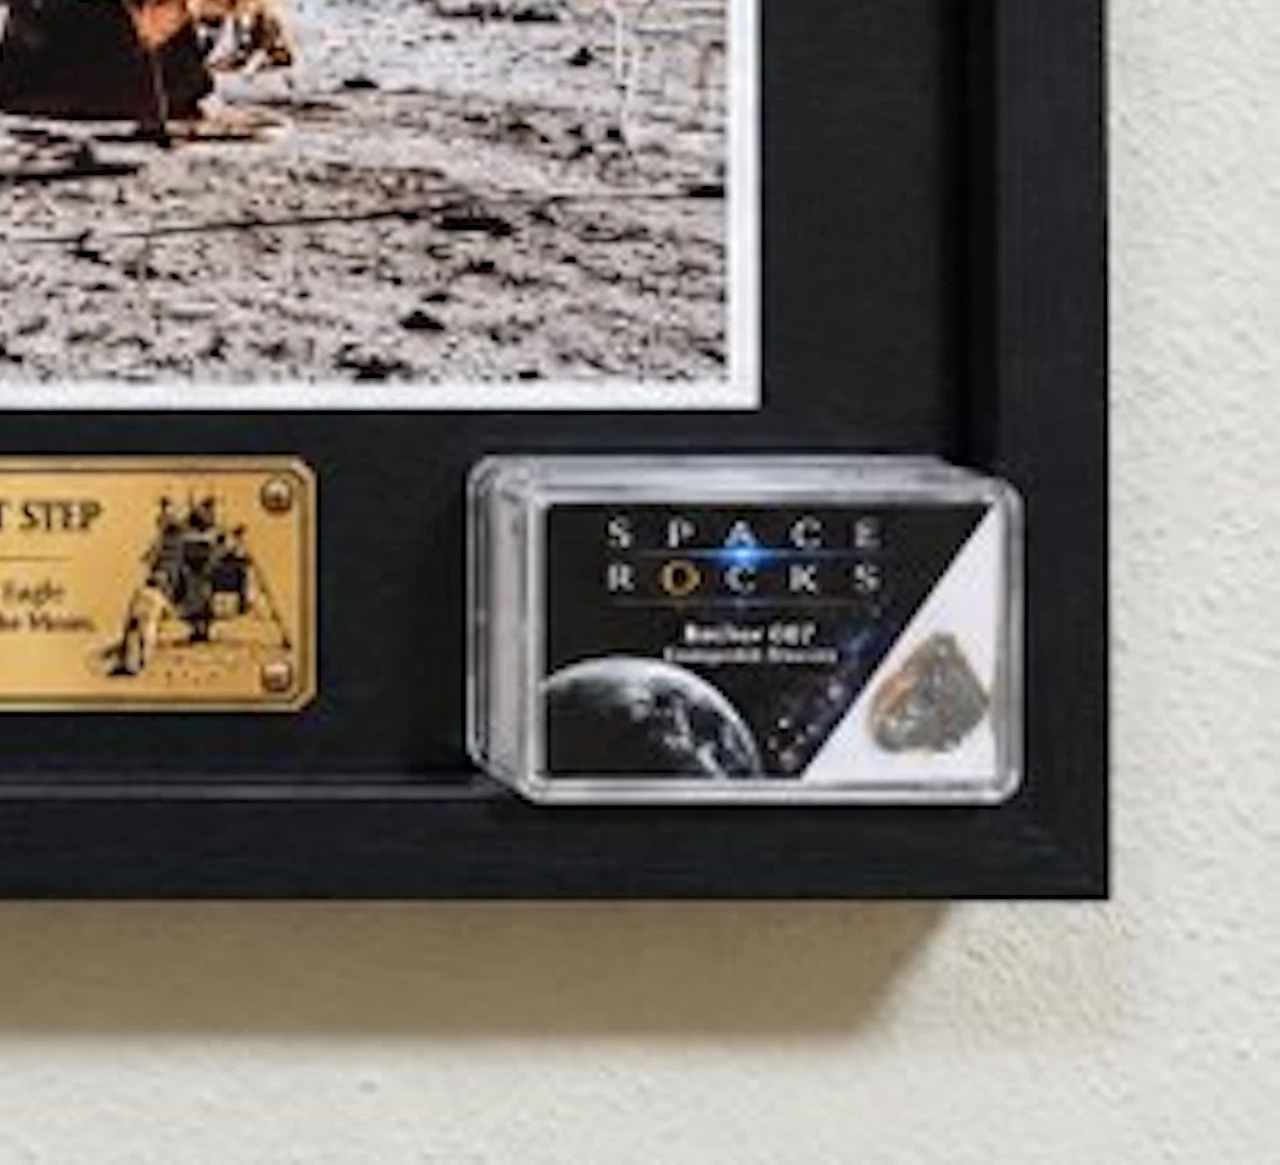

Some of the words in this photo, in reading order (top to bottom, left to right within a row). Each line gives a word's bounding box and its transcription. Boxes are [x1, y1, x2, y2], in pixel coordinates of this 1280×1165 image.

[18, 498, 102, 532] STEP
[607, 516, 880, 549] SPACE
[607, 559, 881, 595] ROCKS
